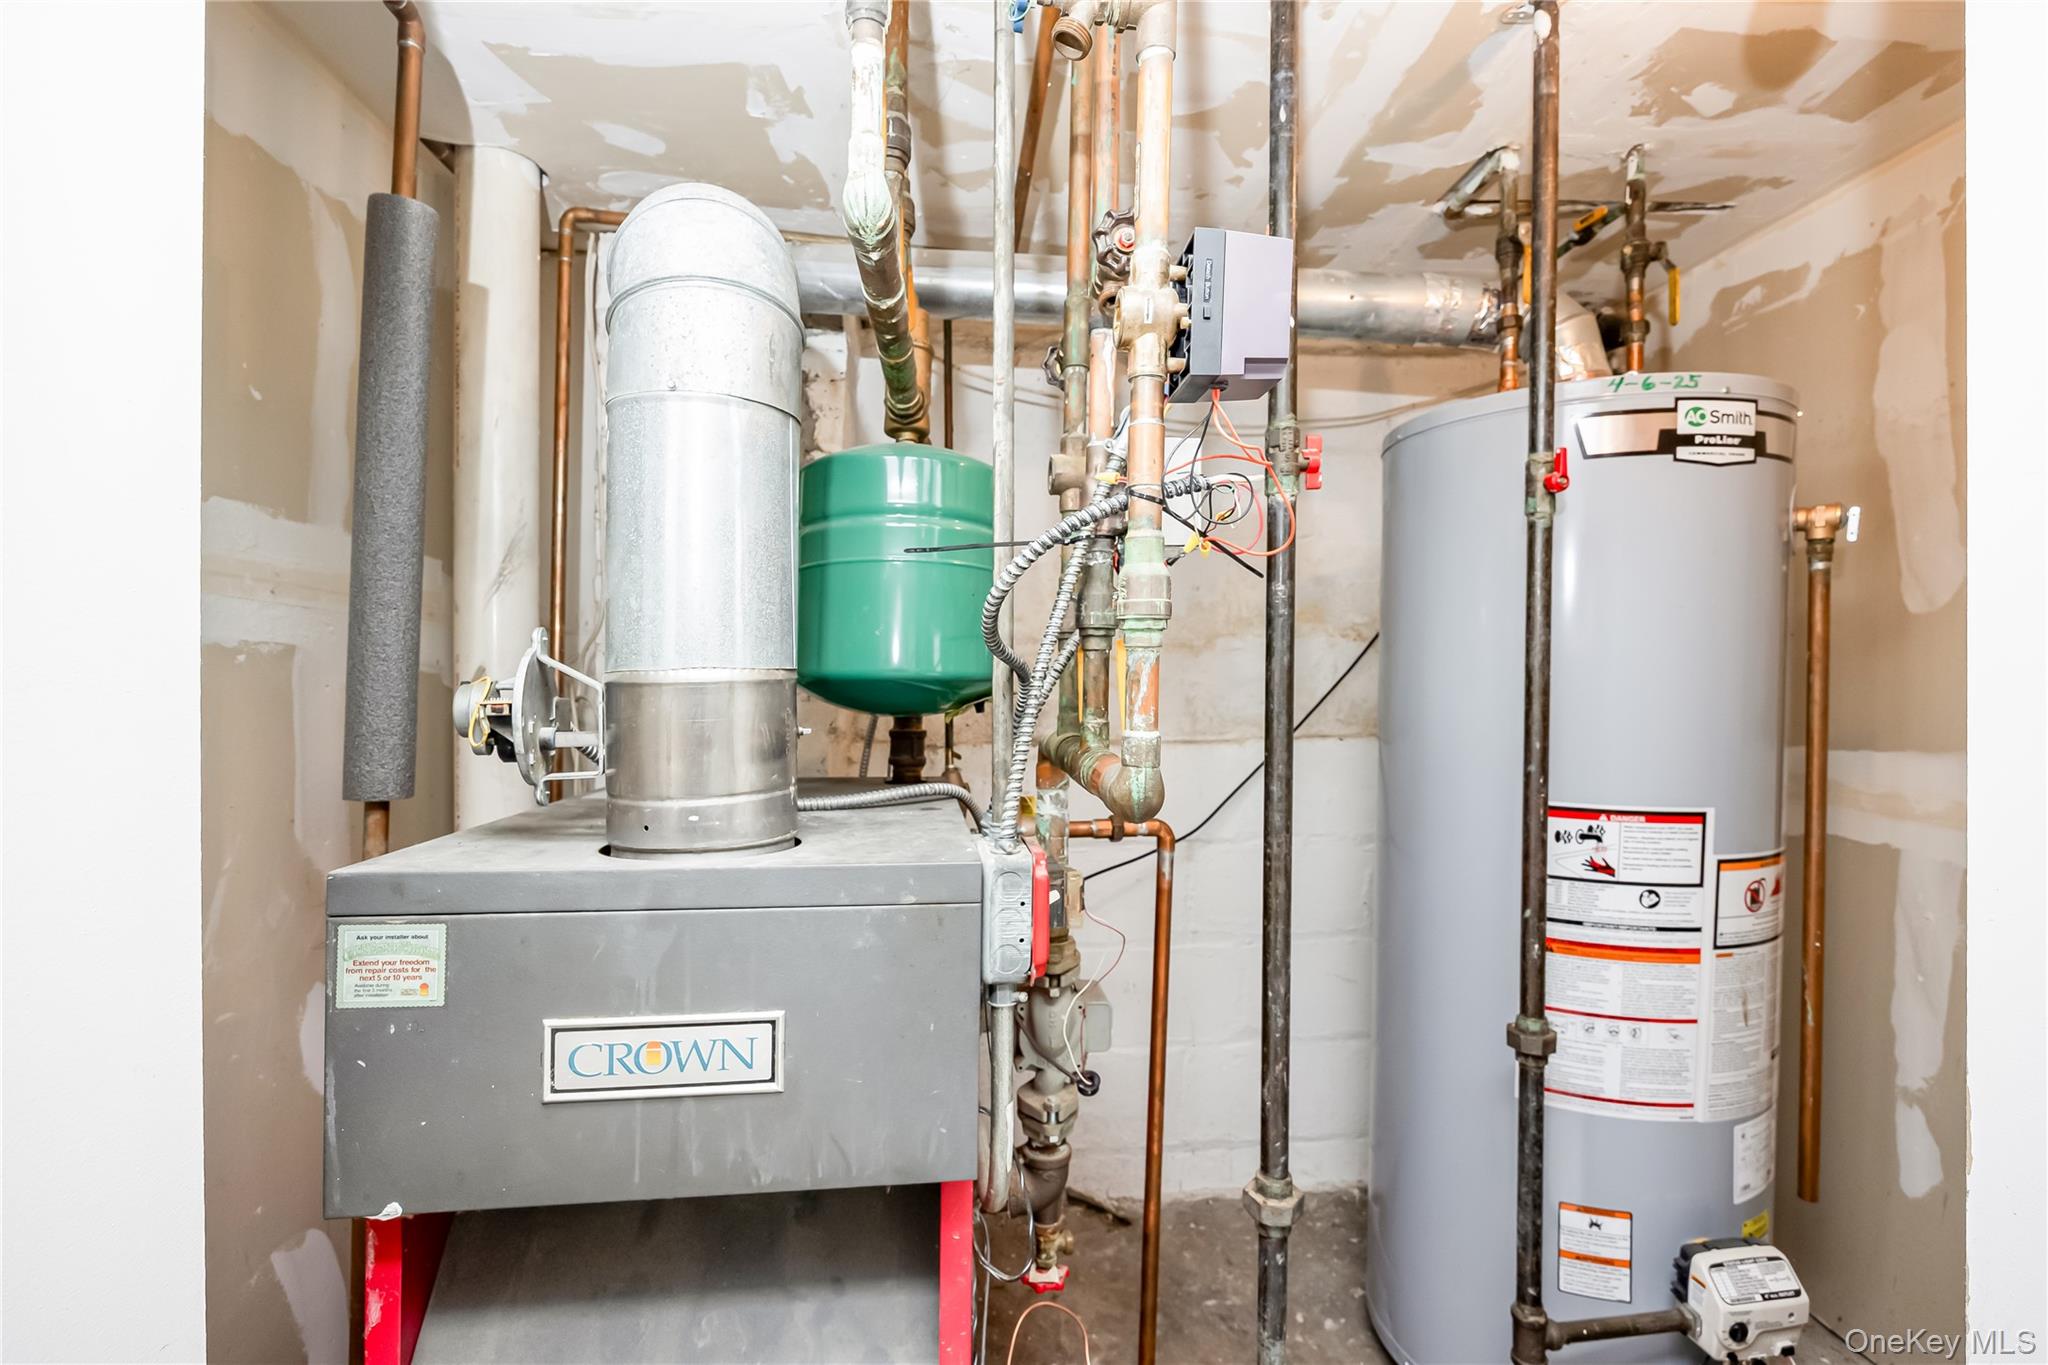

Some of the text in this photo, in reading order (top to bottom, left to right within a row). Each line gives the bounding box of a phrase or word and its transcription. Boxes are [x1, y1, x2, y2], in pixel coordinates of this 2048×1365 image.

[1608, 374, 1702, 393] 4-6-25
[1710, 410, 1752, 426] Smith
[352, 959, 380, 967] Extend
[381, 960, 397, 968] your
[365, 967, 386, 975] repair
[402, 974, 423, 982] years
[568, 1036, 759, 1078] CROWN
